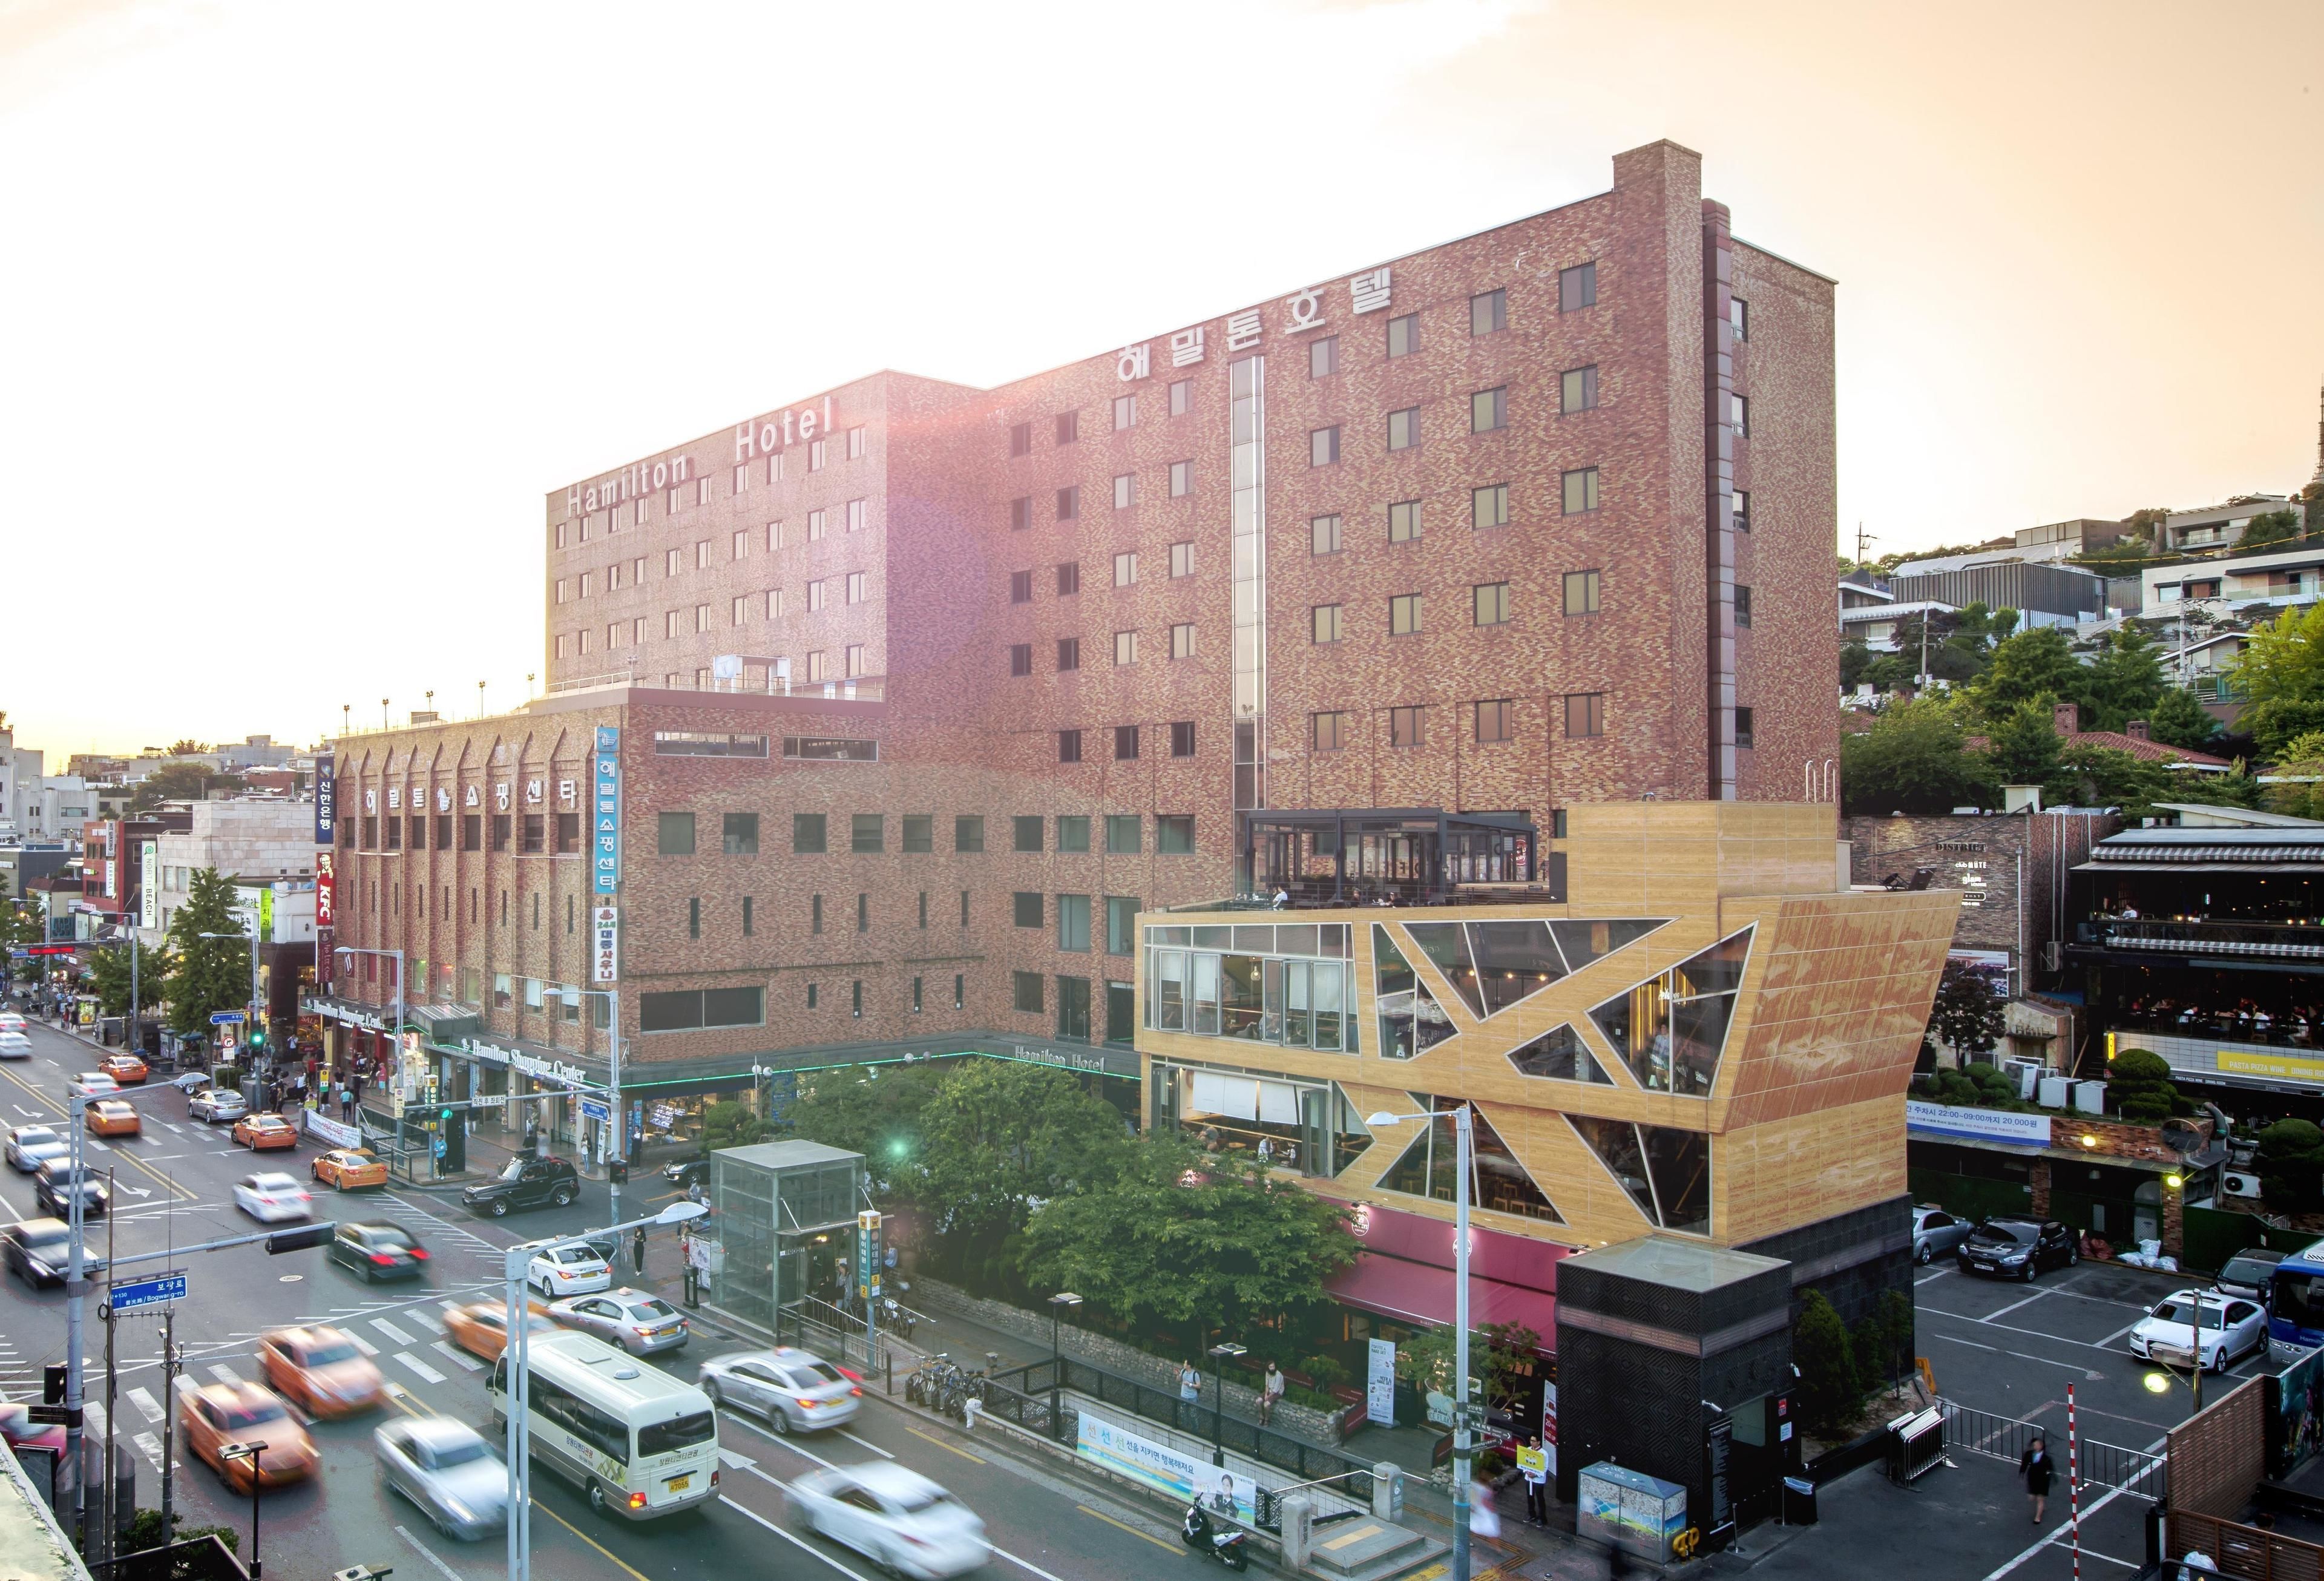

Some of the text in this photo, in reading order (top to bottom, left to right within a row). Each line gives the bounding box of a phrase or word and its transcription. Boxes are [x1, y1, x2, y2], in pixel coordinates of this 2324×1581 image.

[568, 396, 831, 518] Hamilton Hotel
[320, 782, 330, 830] 신한은행
[1936, 842, 1987, 852] DISTRICT
[320, 884, 330, 919] KFC
[262, 909, 269, 926] 치과
[599, 930, 613, 979] 대중사우나
[472, 1039, 586, 1082] Hamilton Shopping Center
[1015, 1045, 1105, 1073] Hamilton Hotel
[2229, 1060, 2249, 1070] PASTA
[2251, 1062, 2268, 1071] PIZZA
[2270, 1064, 2286, 1073] WINE
[2291, 1067, 2313, 1077] DINING
[1914, 1106, 1937, 1116] 주차시
[1938, 1109, 2000, 1124] 22:00~09:00까지
[1087, 1422, 1096, 1439] 선
[1101, 1428, 1110, 1446] 선
[1115, 1435, 1124, 1452] 선
[1126, 1439, 1139, 1453] 선을
[1141, 1444, 1160, 1462] 지키면
[674, 1481, 688, 1491] 7055
